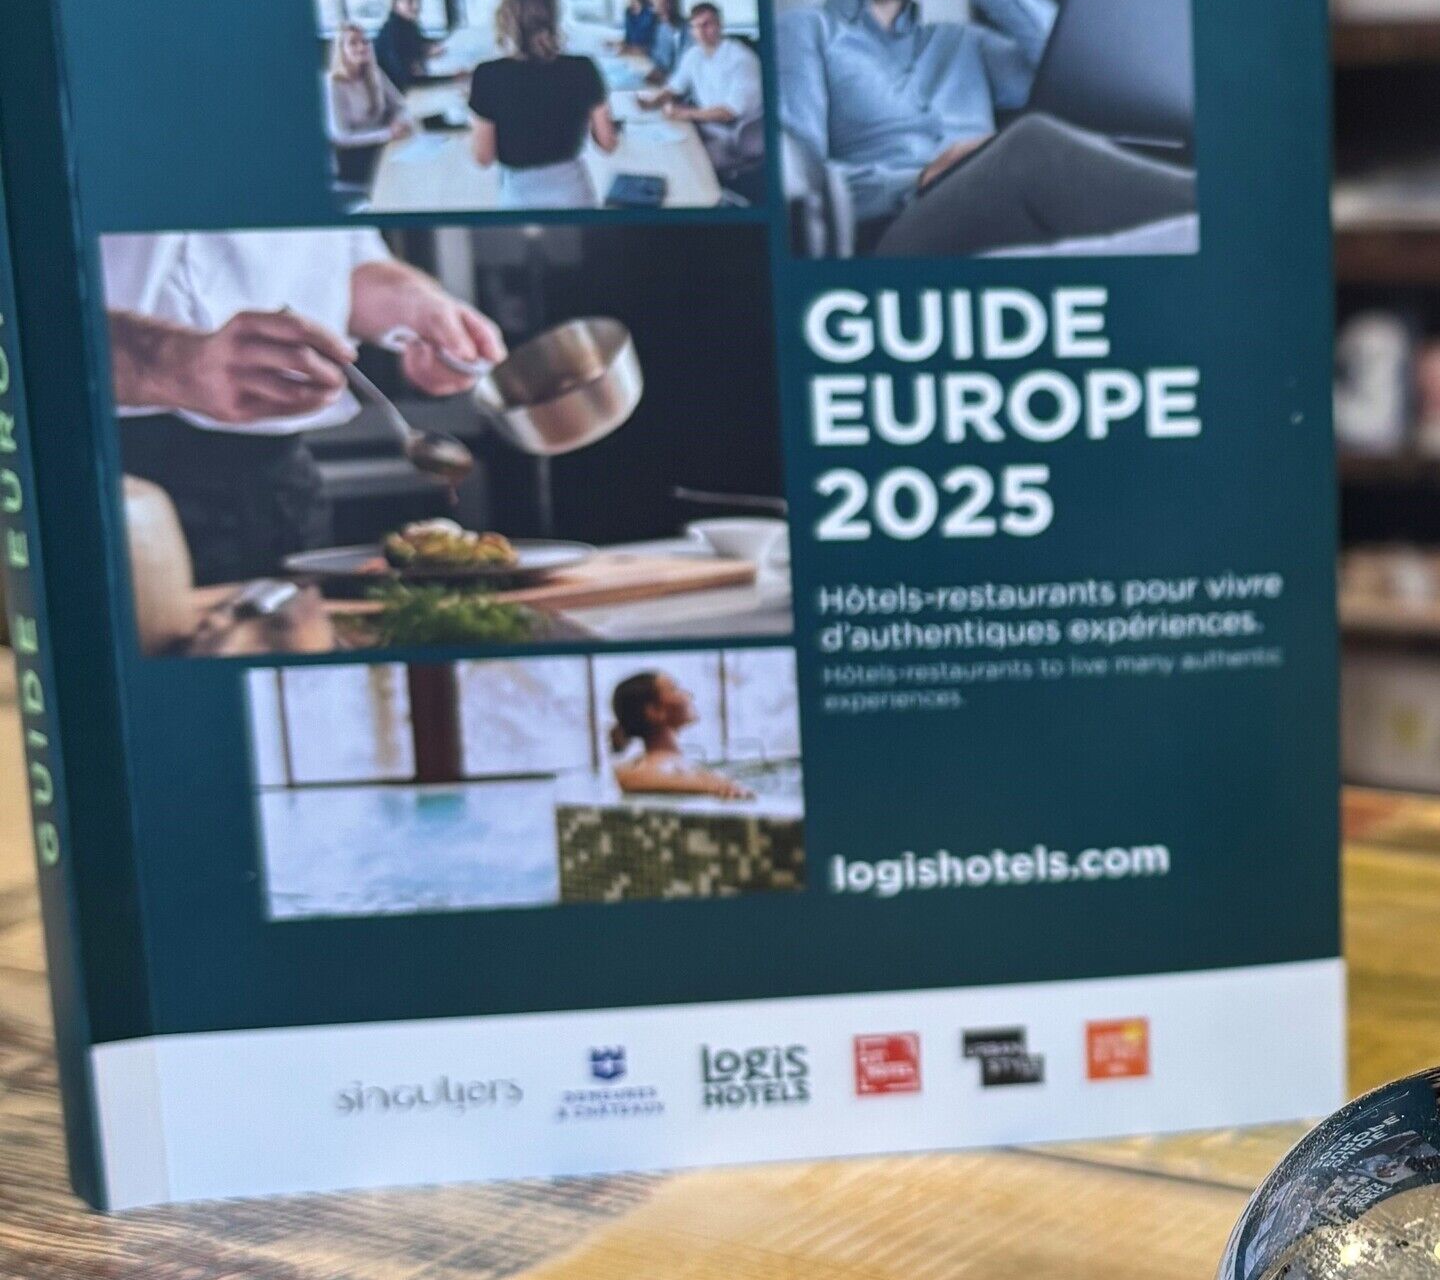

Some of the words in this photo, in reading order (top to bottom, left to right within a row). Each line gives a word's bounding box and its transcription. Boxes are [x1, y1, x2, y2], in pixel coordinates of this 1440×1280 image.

[804, 287, 1110, 361] GUIDE
[808, 367, 1201, 445] EUROPE
[815, 464, 1054, 540] 2025
[818, 579, 1116, 616] Hôtels-restaurants
[1123, 577, 1197, 606] pour
[1204, 572, 1284, 600] vivre
[820, 618, 1061, 653] d'authentiques
[1041, 658, 1065, 679] to
[1115, 653, 1174, 678] many
[13, 614, 60, 867] GUIDE
[831, 844, 1170, 897] logishotels.com
[703, 1079, 811, 1108] HOTELS
